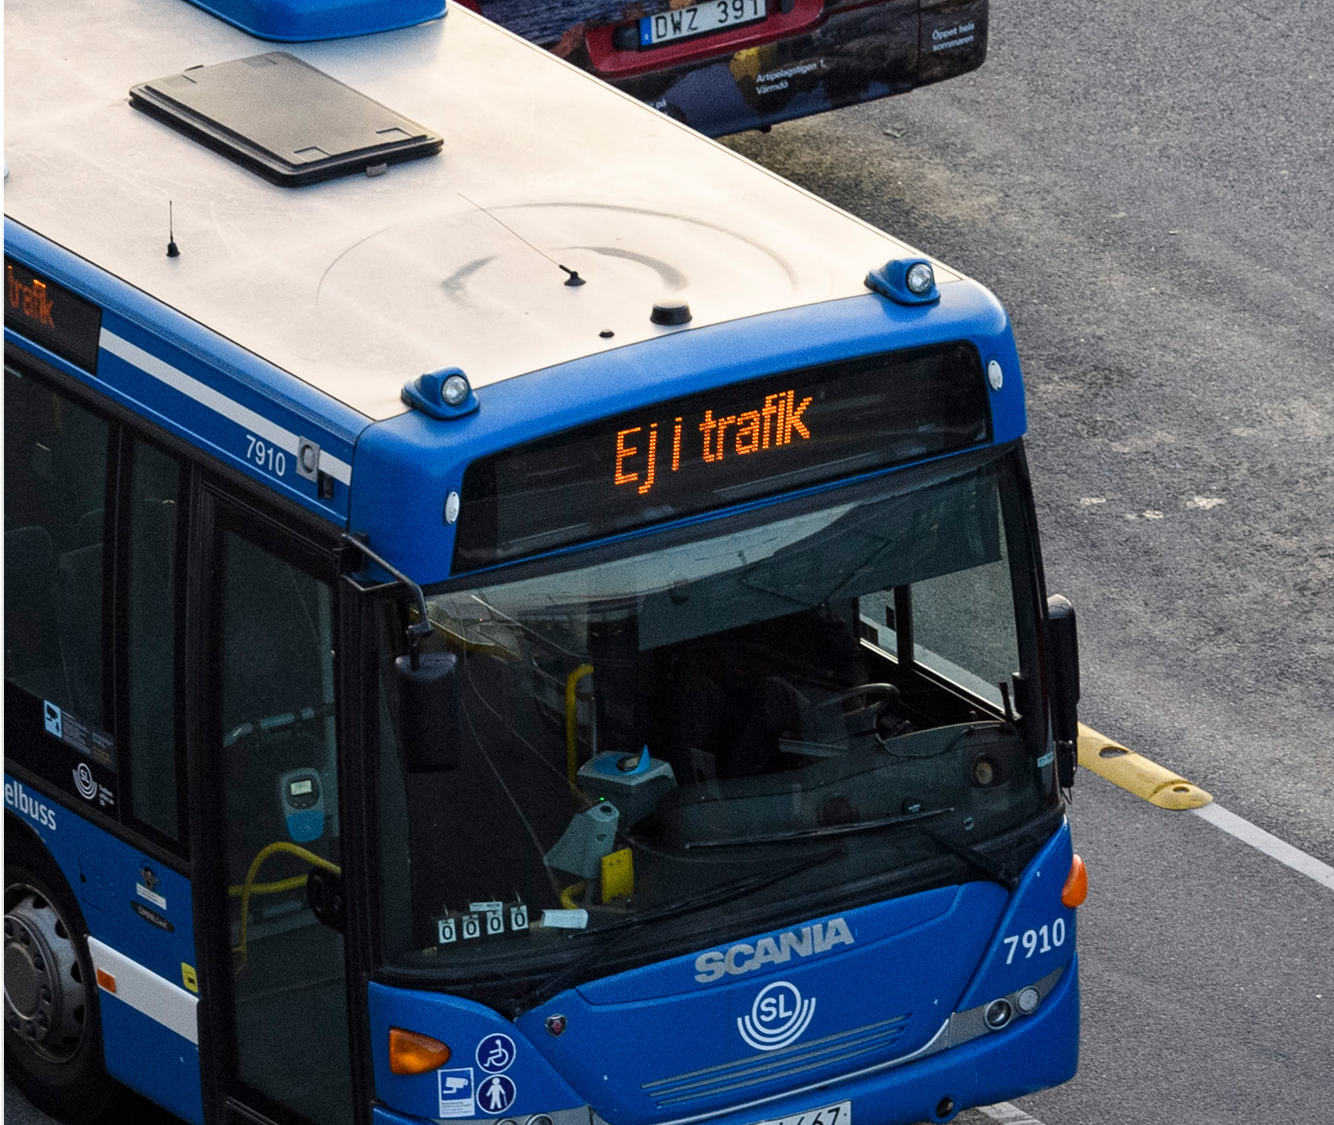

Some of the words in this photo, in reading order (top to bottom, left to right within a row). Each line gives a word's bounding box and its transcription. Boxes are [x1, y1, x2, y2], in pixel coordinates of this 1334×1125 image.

[655, 8, 698, 39] DWZ
[932, 34, 975, 53] sommaren
[246, 434, 286, 477] 7910
[615, 423, 657, 494] Ej
[671, 417, 682, 471] i
[699, 390, 813, 463] trafik
[694, 917, 855, 983] SCANIA
[1003, 917, 1066, 965] 7910
[759, 993, 793, 1022] SL
